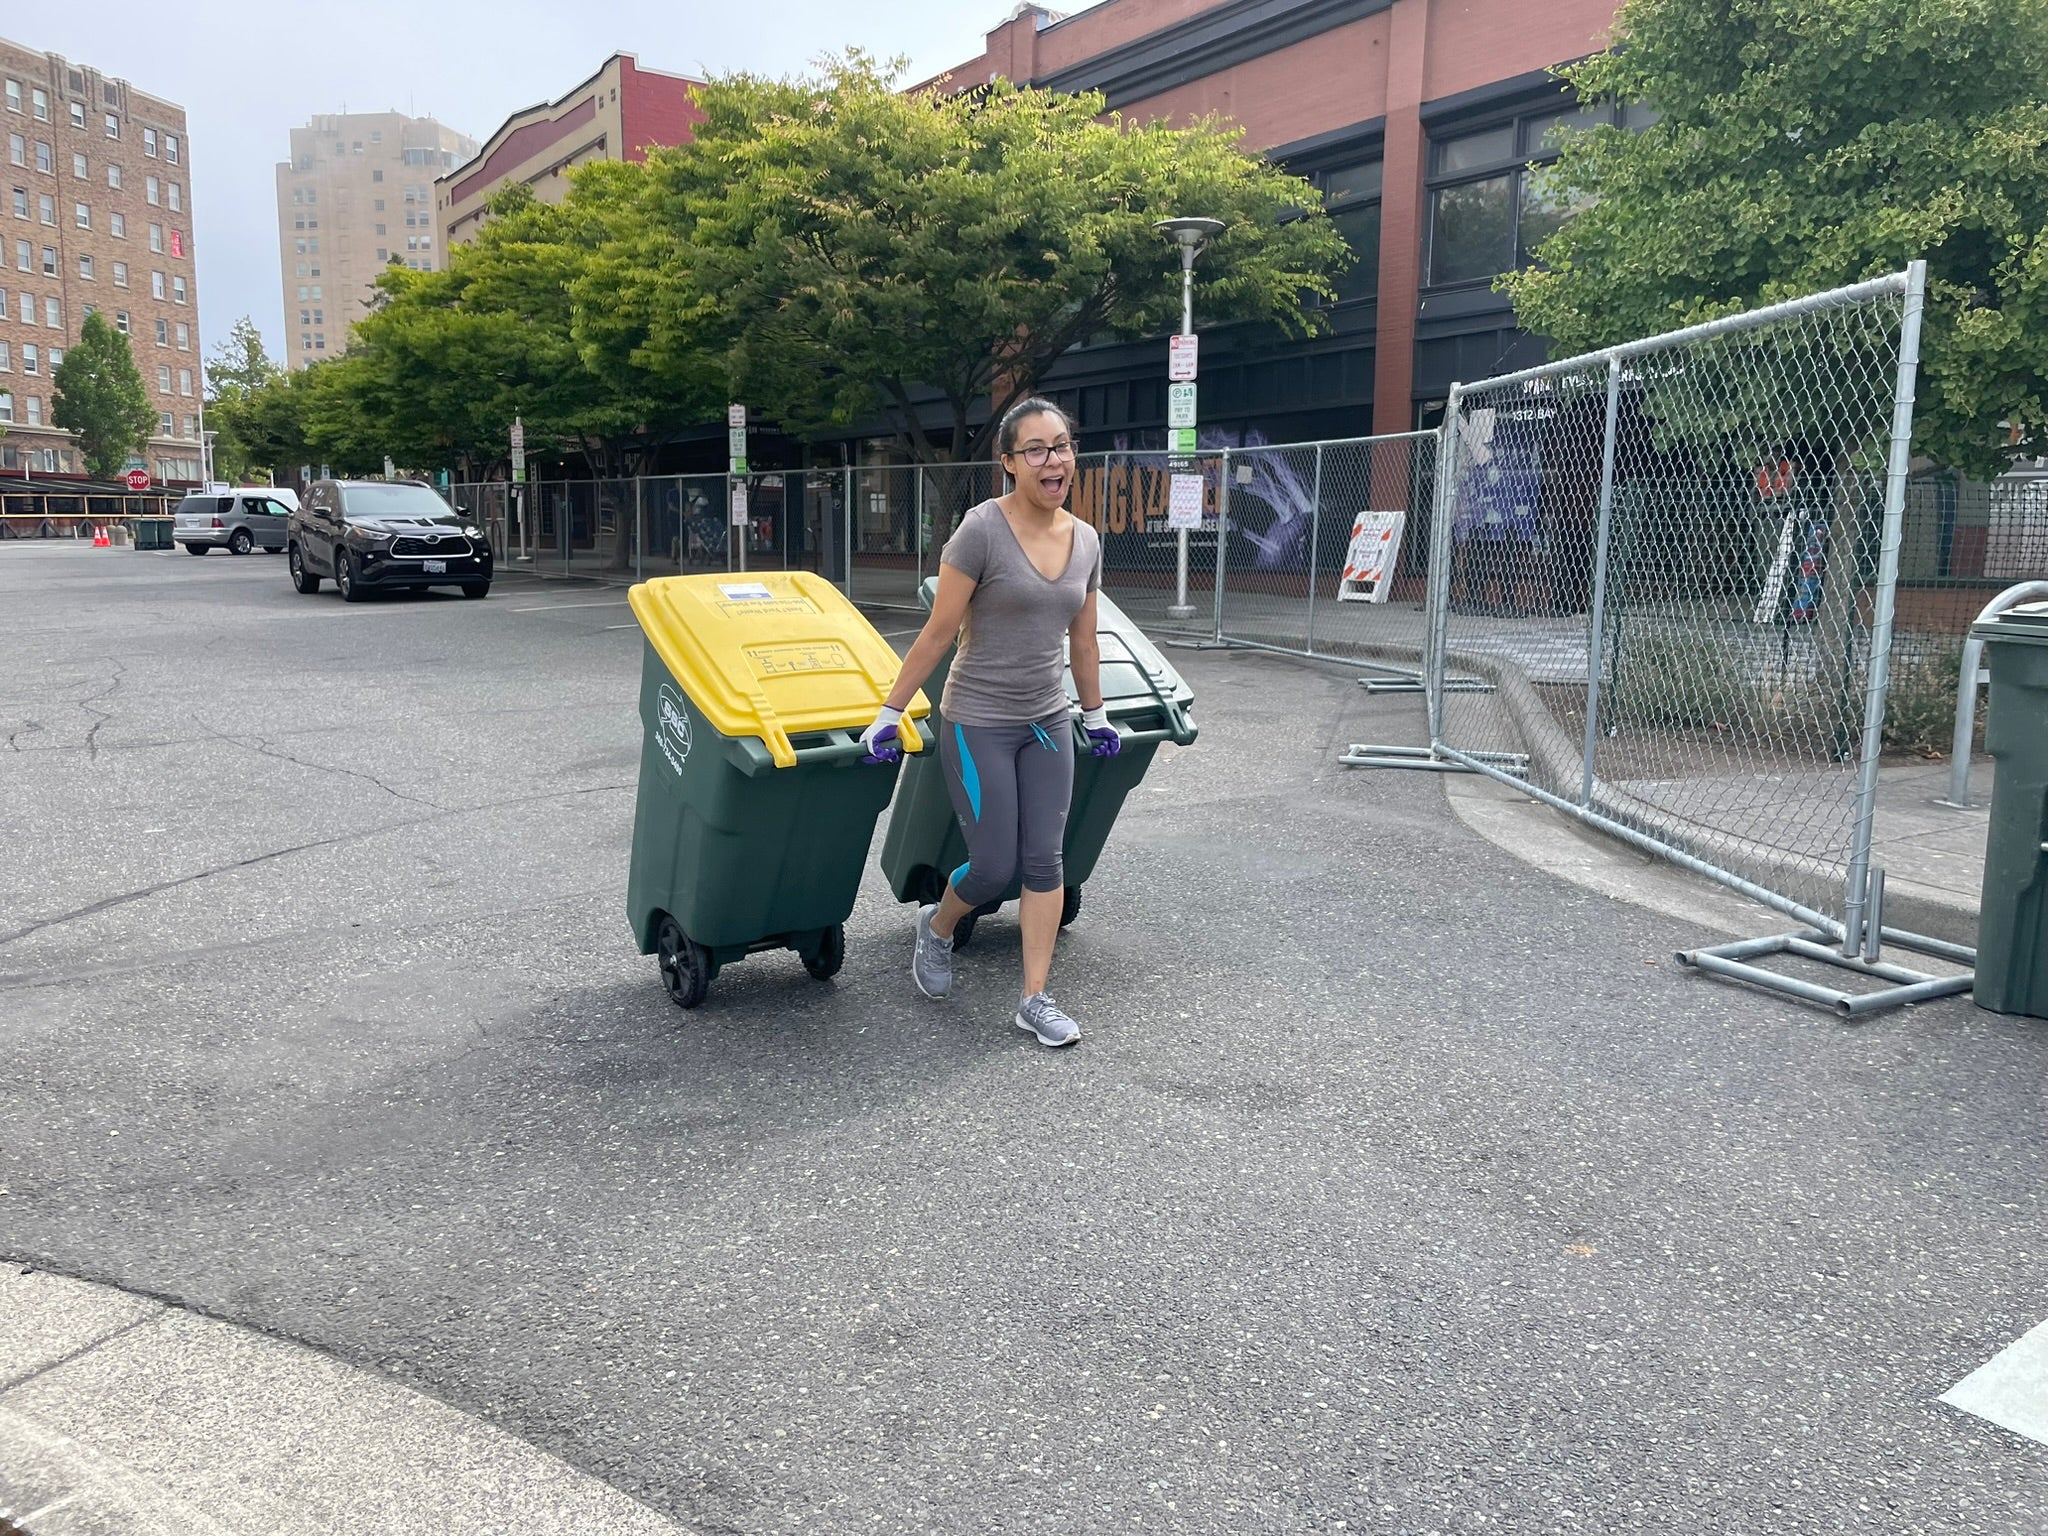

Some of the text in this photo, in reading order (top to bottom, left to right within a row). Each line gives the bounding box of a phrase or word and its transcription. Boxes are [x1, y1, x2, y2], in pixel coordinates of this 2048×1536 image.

[1512, 407, 1555, 421] 1312 BAY
[128, 475, 148, 485] STOP
